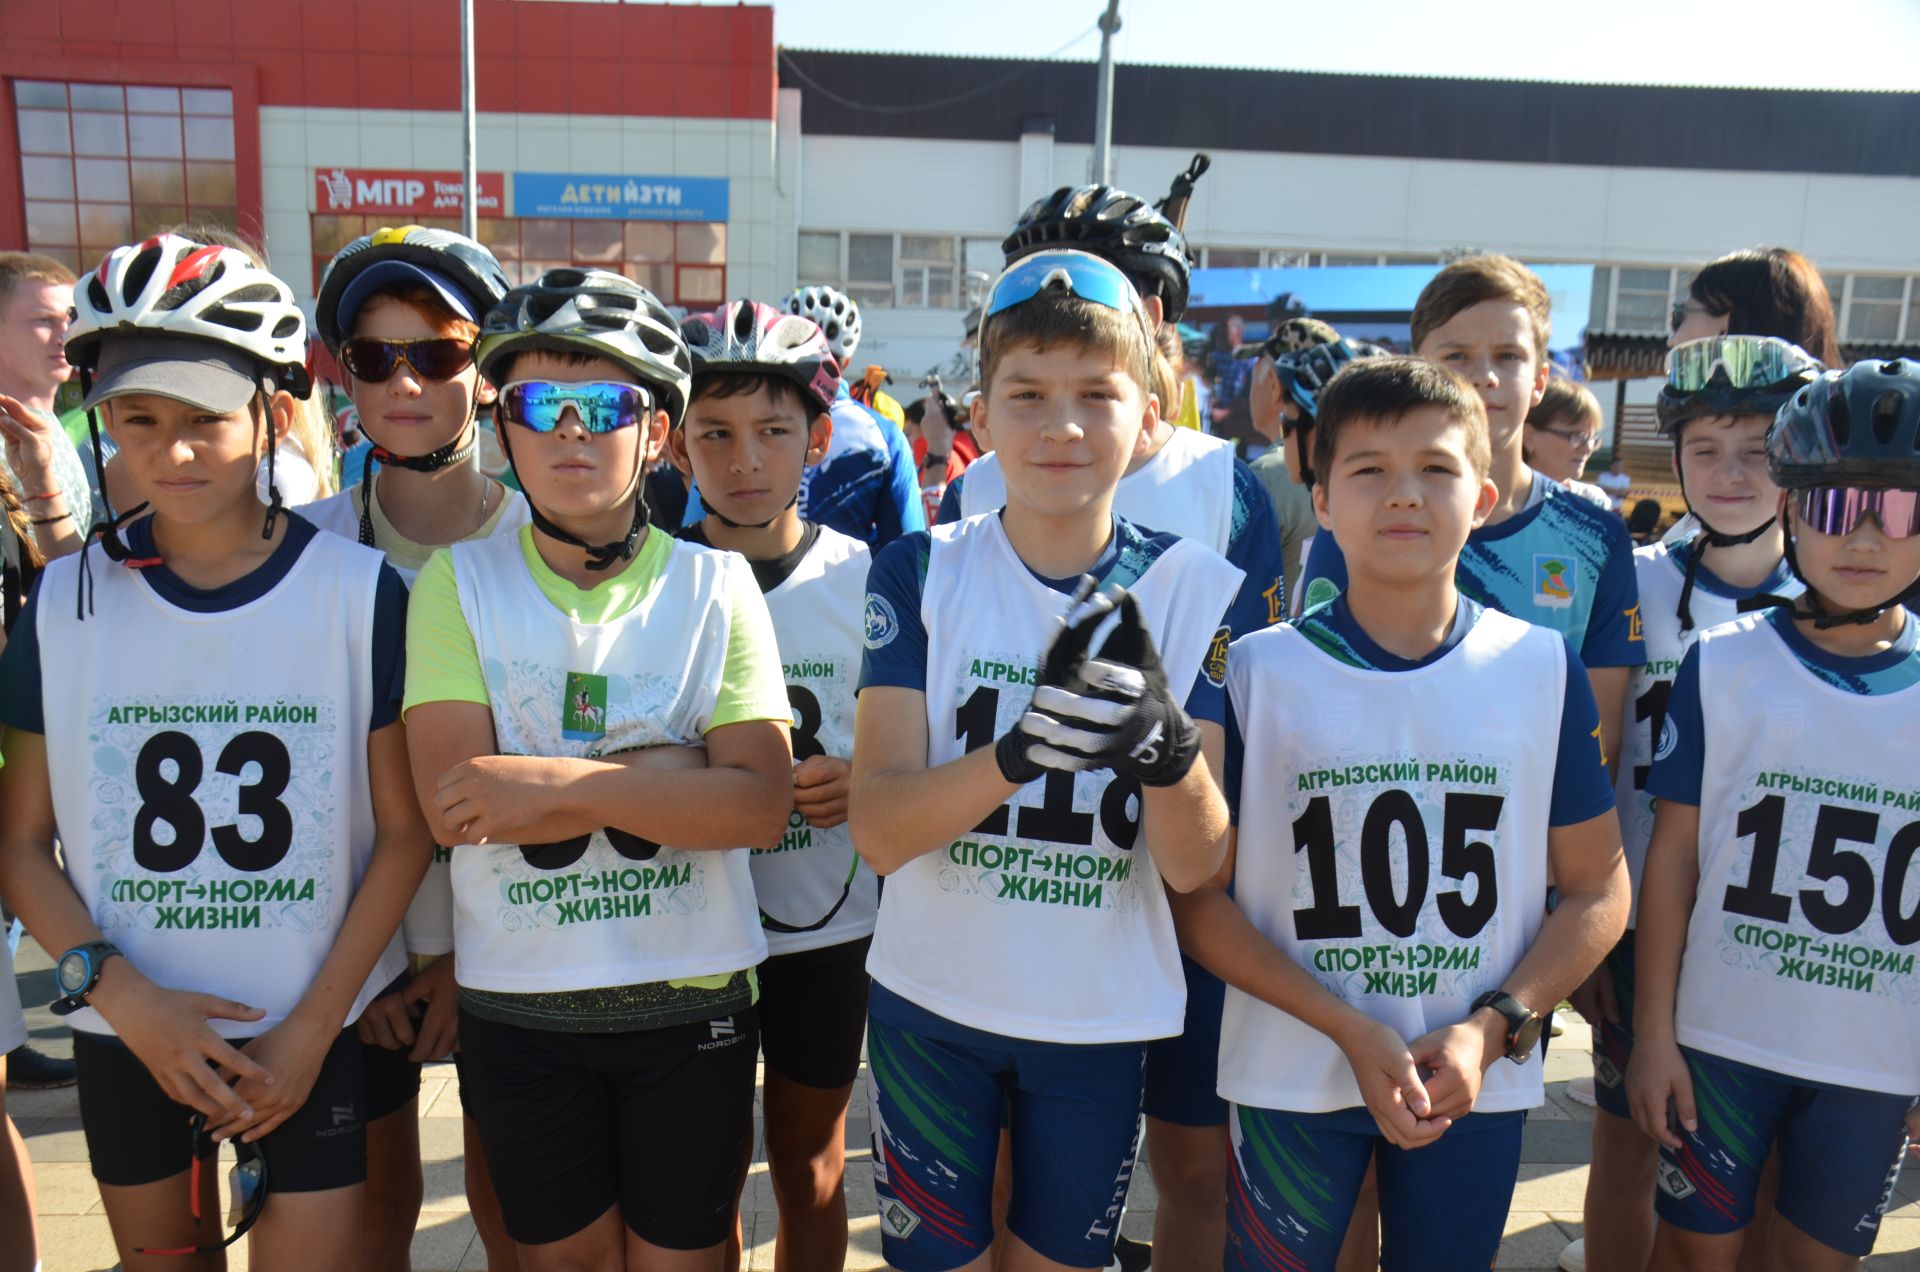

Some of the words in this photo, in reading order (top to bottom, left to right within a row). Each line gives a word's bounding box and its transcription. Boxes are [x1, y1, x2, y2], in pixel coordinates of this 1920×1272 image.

[356, 179, 425, 206] МПР
[970, 658, 1040, 687] АГРЫЗ
[107, 700, 238, 724] АГРЫЗСКИЙ
[245, 700, 317, 723] РАЙОН
[1298, 757, 1419, 791] АГРЫЗСКИЙ
[1426, 757, 1497, 785] РАЙОН
[1756, 771, 1878, 804] АГРЫЗСКИЙ
[133, 731, 293, 873] 83
[949, 840, 1034, 873] СПОРТ
[1292, 789, 1505, 941] 105
[111, 878, 187, 902] СПОРТ
[209, 878, 315, 902] НОРМА
[507, 871, 584, 907] СПОРТ
[602, 861, 692, 893] НОРМА
[996, 873, 1103, 909] ЖИЗНИ
[154, 904, 261, 930] ЖИЗНИ
[555, 891, 652, 926] ЖИЗНИ
[1314, 944, 1392, 973] СПОРТ
[1732, 923, 1812, 957] СПОРТ
[1831, 942, 1915, 976] НОРМА
[1776, 955, 1875, 993] ЖИЗНИ
